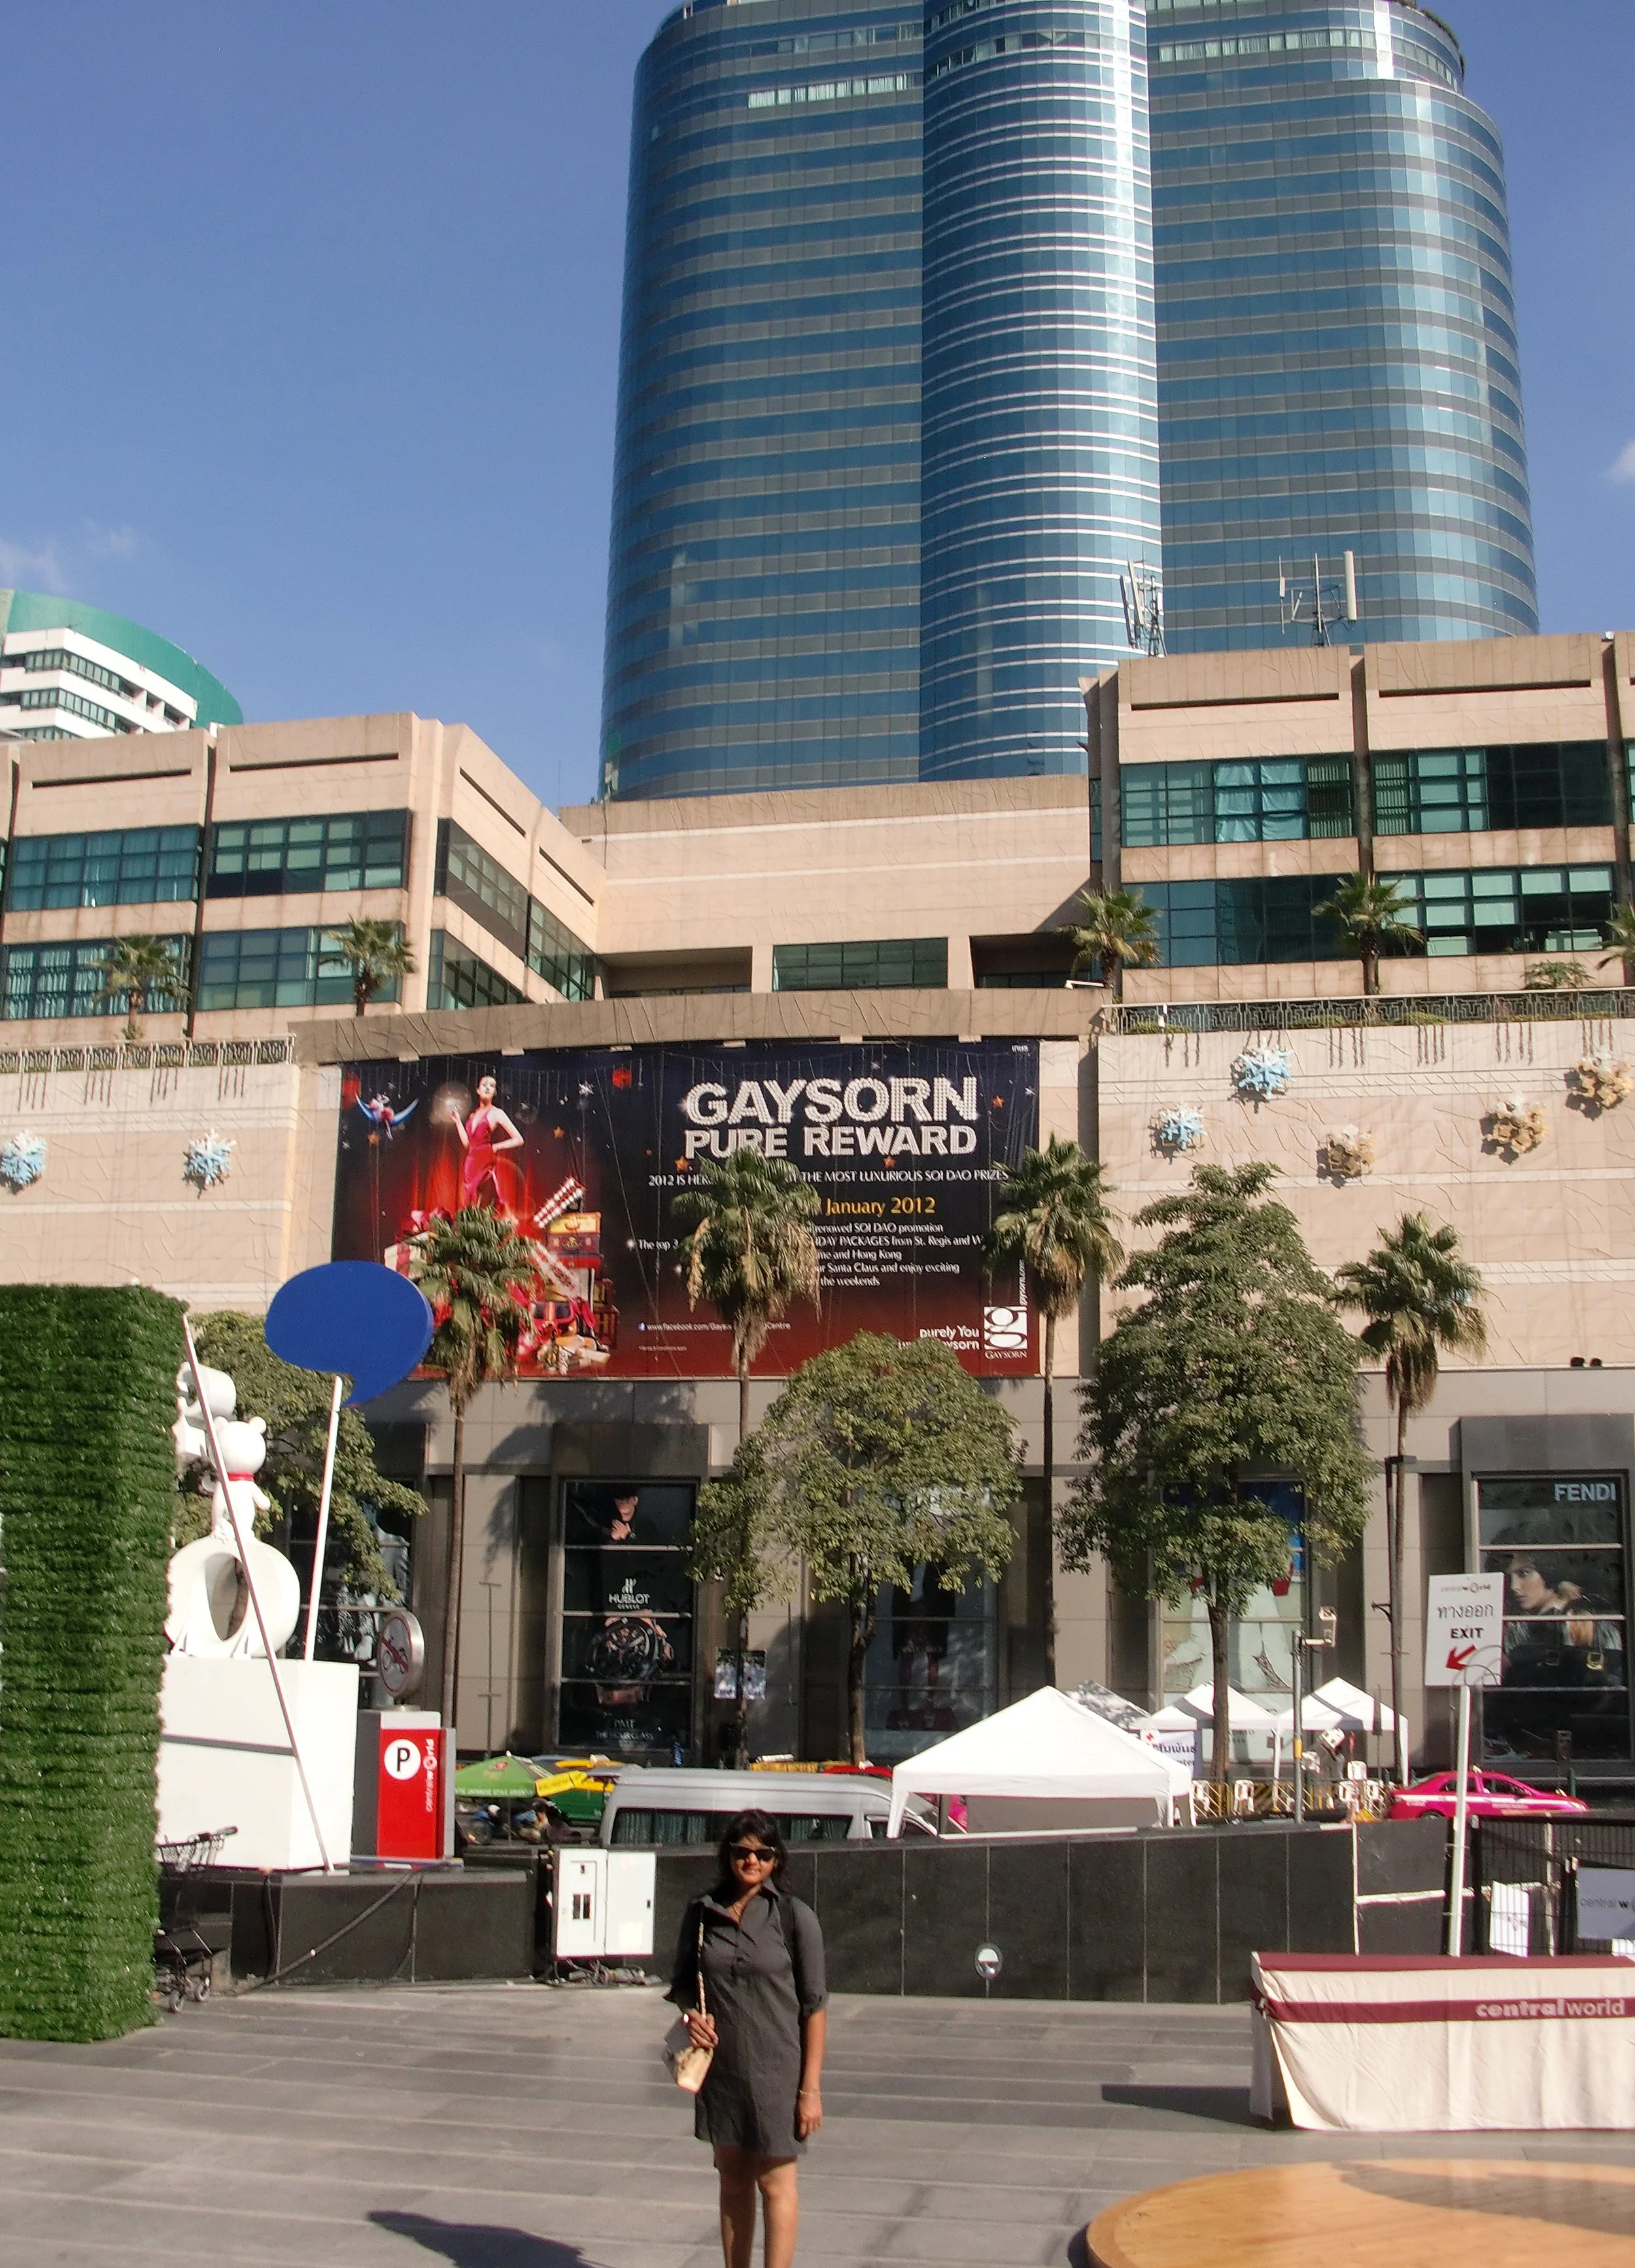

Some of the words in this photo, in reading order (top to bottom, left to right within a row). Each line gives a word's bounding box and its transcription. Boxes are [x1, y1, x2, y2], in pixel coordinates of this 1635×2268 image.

[687, 1076, 978, 1126] GAYSORN
[685, 1127, 788, 1159] PURE
[804, 1125, 977, 1157] REWARD
[648, 1175, 674, 1186] 2012
[677, 1174, 685, 1185] IS
[688, 1174, 717, 1185] HER
[801, 1171, 823, 1183] THE
[825, 1170, 857, 1183] MOST
[946, 1169, 972, 1181] DAO
[825, 1198, 886, 1218] January
[891, 1196, 936, 1214] 2012
[854, 1222, 871, 1233] SOI
[874, 1222, 897, 1233] DAO
[899, 1222, 944, 1234] promotion
[636, 1238, 655, 1250] The
[656, 1239, 670, 1251] top
[839, 1235, 889, 1246] PACKAGES
[891, 1235, 912, 1246] from
[914, 1235, 926, 1246] St.
[928, 1235, 952, 1247] Regis
[953, 1234, 971, 1246] and
[833, 1249, 850, 1260] and
[852, 1249, 877, 1261] Hong
[879, 1248, 902, 1261] Kong
[827, 1263, 852, 1273] Santa
[853, 1262, 879, 1273] Claus
[880, 1262, 898, 1273] and
[899, 1263, 923, 1274] enjoy
[925, 1262, 960, 1274] exciting
[820, 1275, 835, 1287] the
[836, 1276, 880, 1287] weekends
[920, 1325, 957, 1341] purely
[957, 1325, 980, 1338] You
[984, 1350, 1027, 1359] GAYSORN
[1554, 1483, 1616, 1501] FENDI
[608, 1593, 651, 1604] HUBLOT
[1437, 1604, 1494, 1618] ทางออก
[1451, 1627, 1484, 1639] EXIT
[396, 1747, 411, 1771] P
